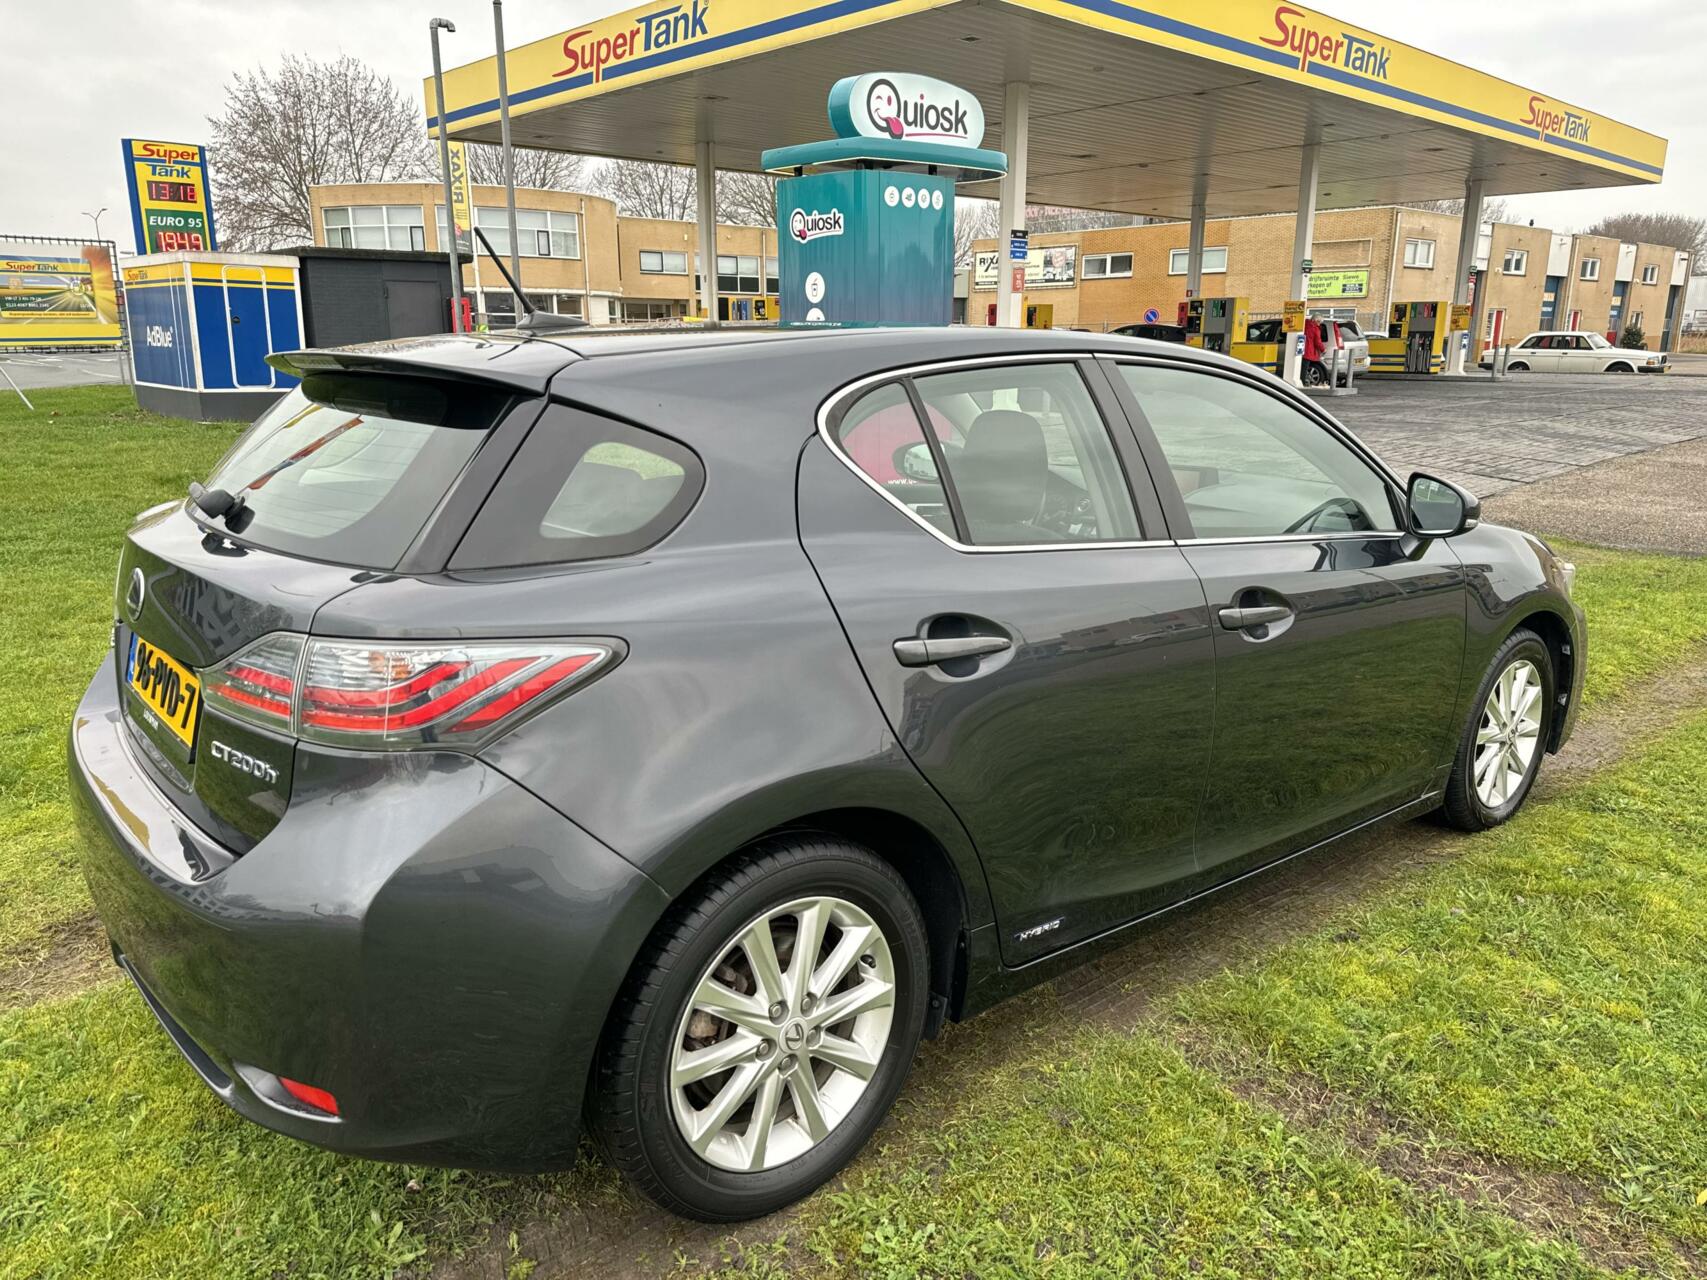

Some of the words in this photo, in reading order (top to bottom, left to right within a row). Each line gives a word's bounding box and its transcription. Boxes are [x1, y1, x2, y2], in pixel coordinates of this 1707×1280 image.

[552, 0, 709, 83] SuperTank
[1259, 6, 1390, 80] SuperTank
[866, 78, 968, 140] Quiosk
[1519, 95, 1591, 142] SuperTank
[134, 144, 198, 164] Super
[145, 164, 192, 179] Tank
[149, 216, 184, 226] EURO
[188, 218, 202, 227] 95
[790, 210, 842, 241] Quiosk
